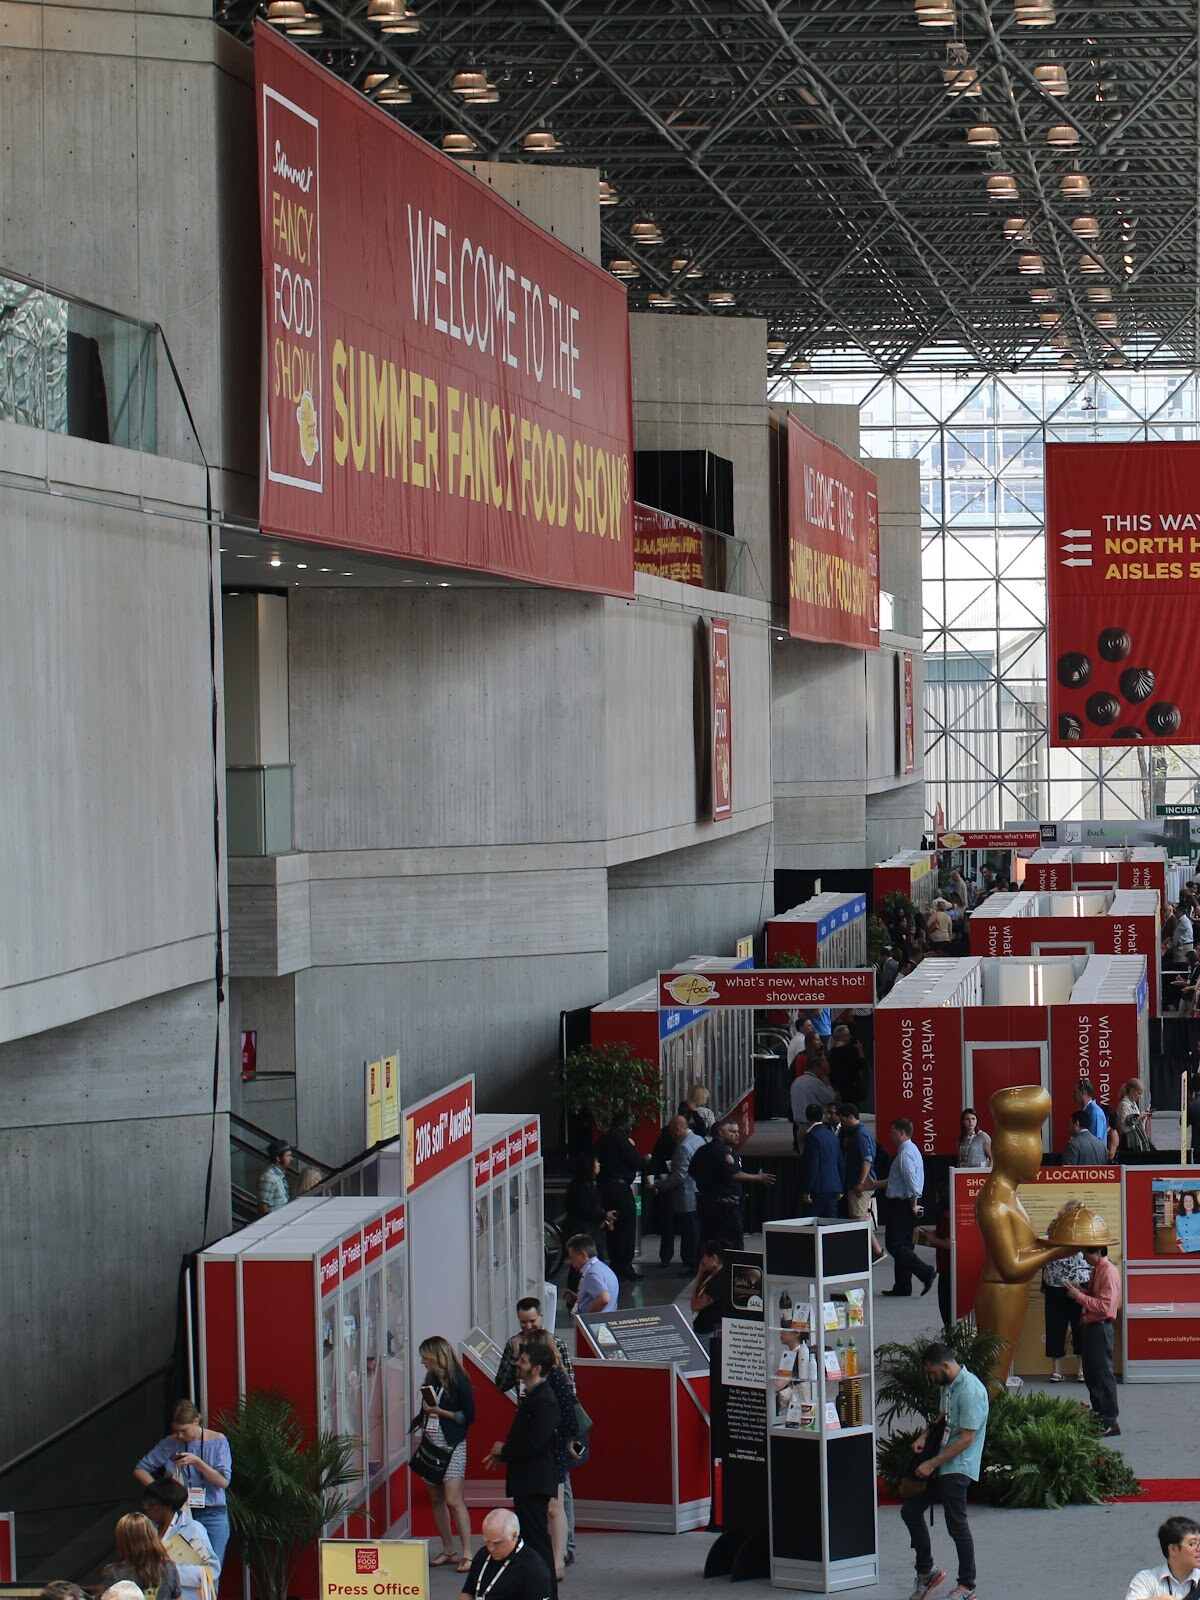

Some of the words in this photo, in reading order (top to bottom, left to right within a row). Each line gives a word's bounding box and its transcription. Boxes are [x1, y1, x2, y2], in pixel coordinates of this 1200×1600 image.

[273, 191, 313, 266] FANCY
[273, 263, 314, 338] FOOD
[407, 204, 518, 368] WELCOME
[520, 276, 545, 382] TO
[548, 294, 581, 400] THE
[275, 338, 315, 404] SHOW
[332, 338, 441, 492] SUMMER
[447, 386, 516, 512] FANCY
[521, 418, 569, 526] FOOD
[804, 464, 834, 531] WELCOME
[1102, 514, 1152, 532] THIS
[1105, 538, 1183, 554] NORTH
[1105, 562, 1184, 580] AISLES
[1003, 926, 1013, 956] what
[1128, 924, 1138, 954] what
[686, 979, 712, 1003] food
[726, 976, 764, 986] what's
[768, 978, 796, 988] new,
[800, 976, 838, 986] what's
[842, 976, 866, 986] hot!
[766, 992, 825, 1001] showcase
[902, 1020, 915, 1098] showcase
[922, 1019, 935, 1072] what's
[1099, 1016, 1112, 1068] what's
[922, 1074, 932, 1113] new,
[416, 1122, 430, 1165] 2016
[449, 1098, 471, 1144] Awards
[924, 1118, 936, 1156] wha
[967, 1179, 988, 1187] SHO
[1046, 1170, 1114, 1180] LOCATIONS
[328, 1584, 368, 1594] Press
[374, 1584, 419, 1594] Office
